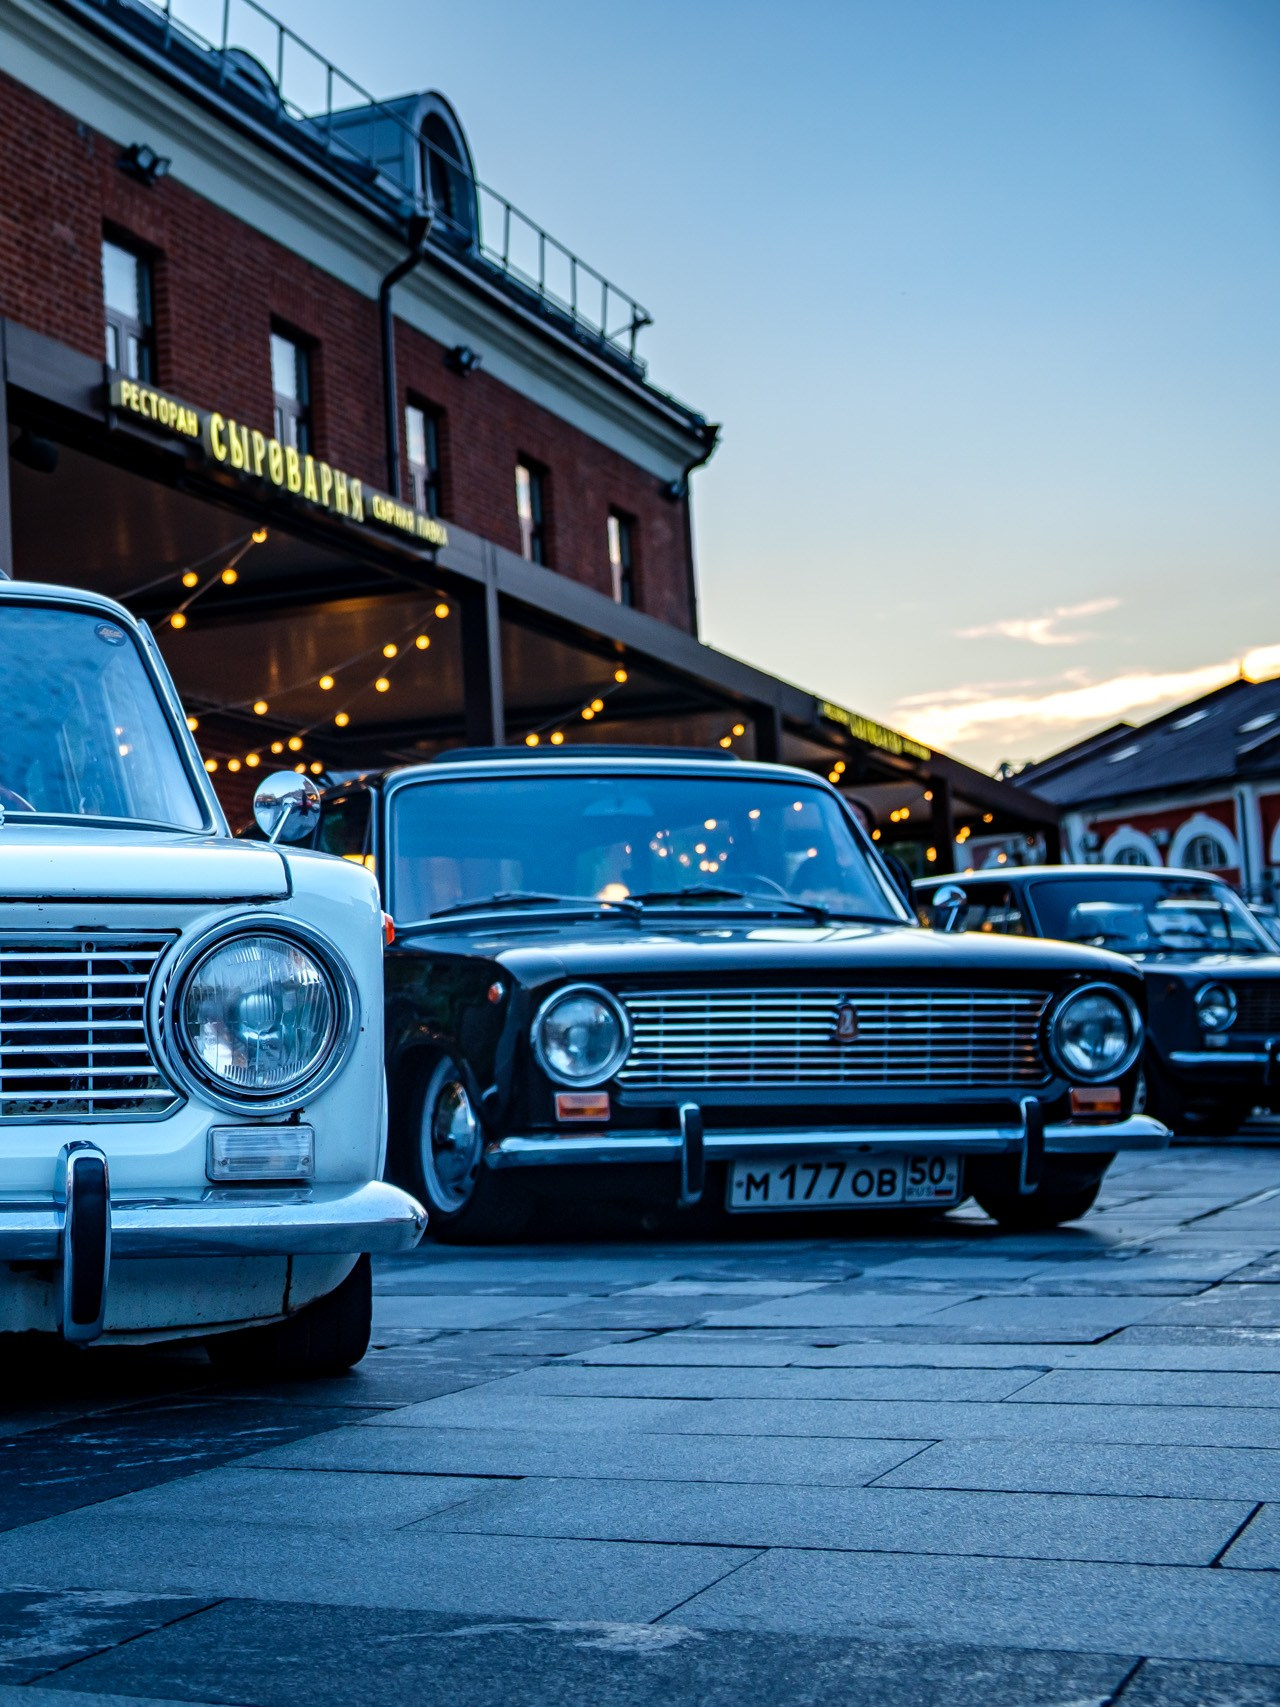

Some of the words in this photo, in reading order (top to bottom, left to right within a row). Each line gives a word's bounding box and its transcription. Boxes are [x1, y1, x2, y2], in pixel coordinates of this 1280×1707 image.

[120, 380, 198, 438] РЕСТОРАН
[210, 413, 364, 523] СЫРОВАРНЯ
[909, 1155, 946, 1185] 50
